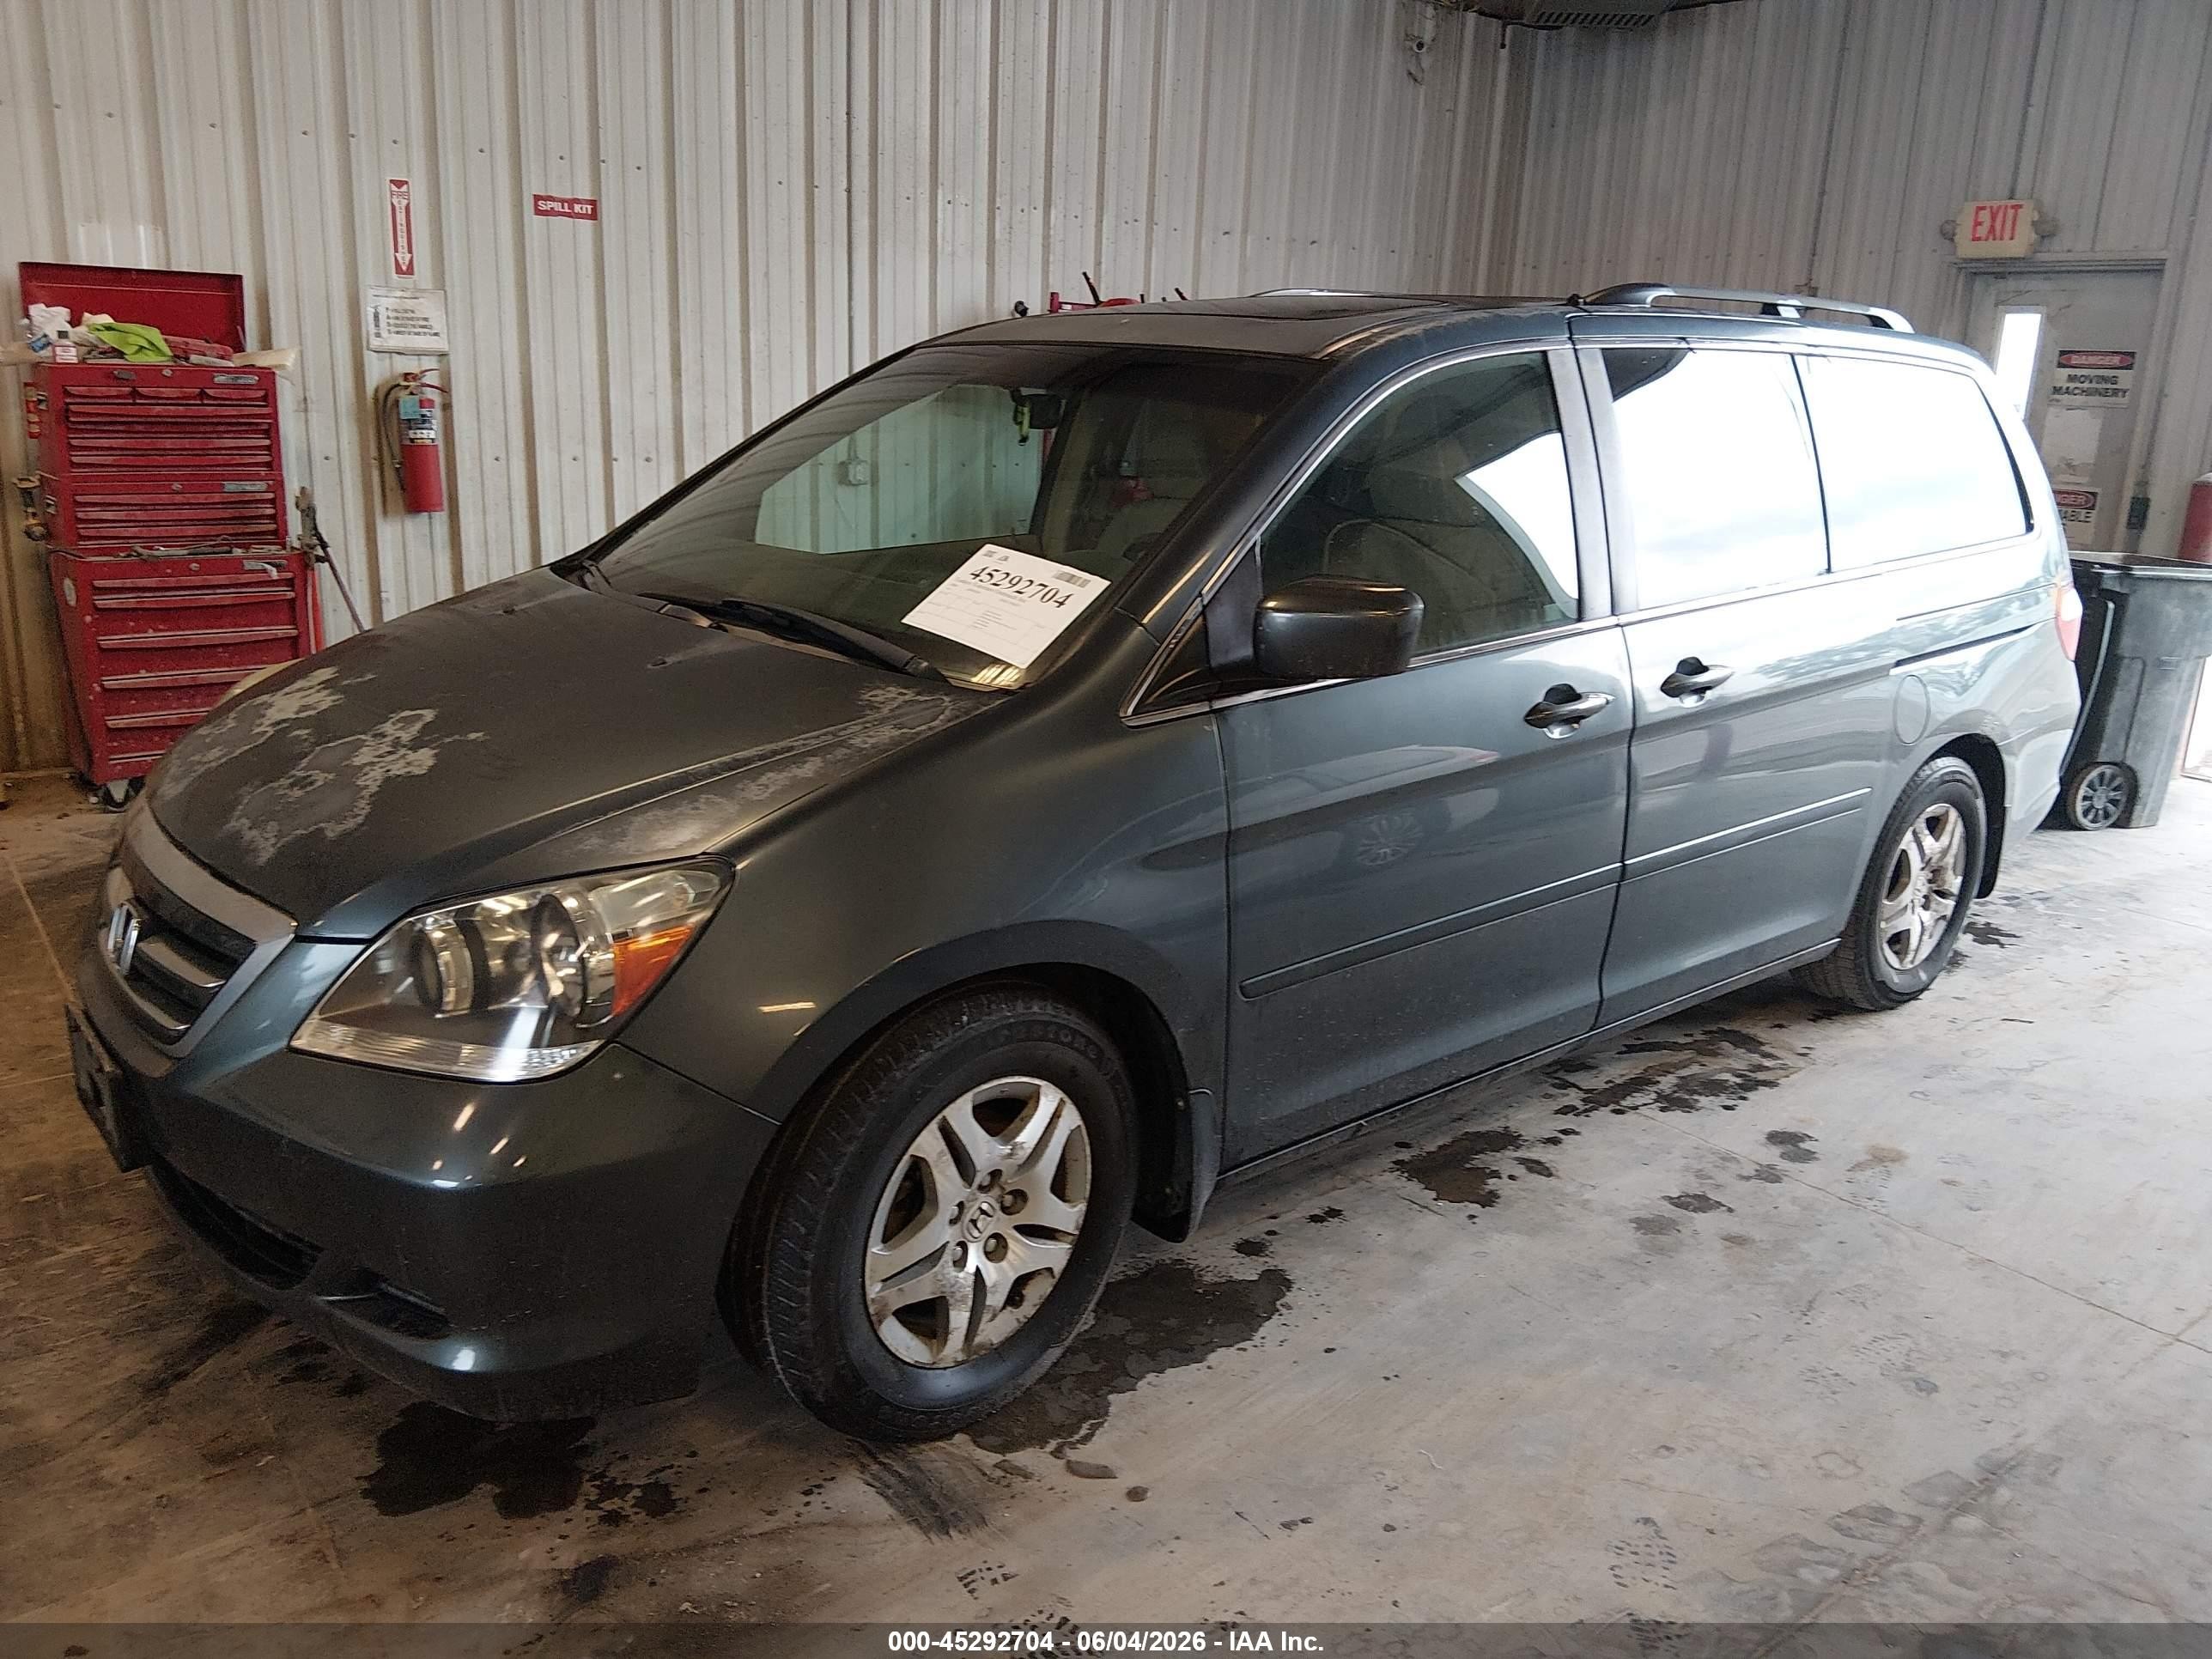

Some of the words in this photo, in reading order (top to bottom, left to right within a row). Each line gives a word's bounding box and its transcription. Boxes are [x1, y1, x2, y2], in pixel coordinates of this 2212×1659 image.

[391, 190, 410, 200] FIRE
[538, 200, 573, 213] SPILL
[574, 204, 594, 215] KIT
[1971, 204, 2024, 242] EXIT
[2070, 355, 2121, 365] DANGER
[2066, 374, 2119, 386] MOVING
[2051, 386, 2130, 398] MACHINERY
[969, 566, 1074, 608] 45292704
